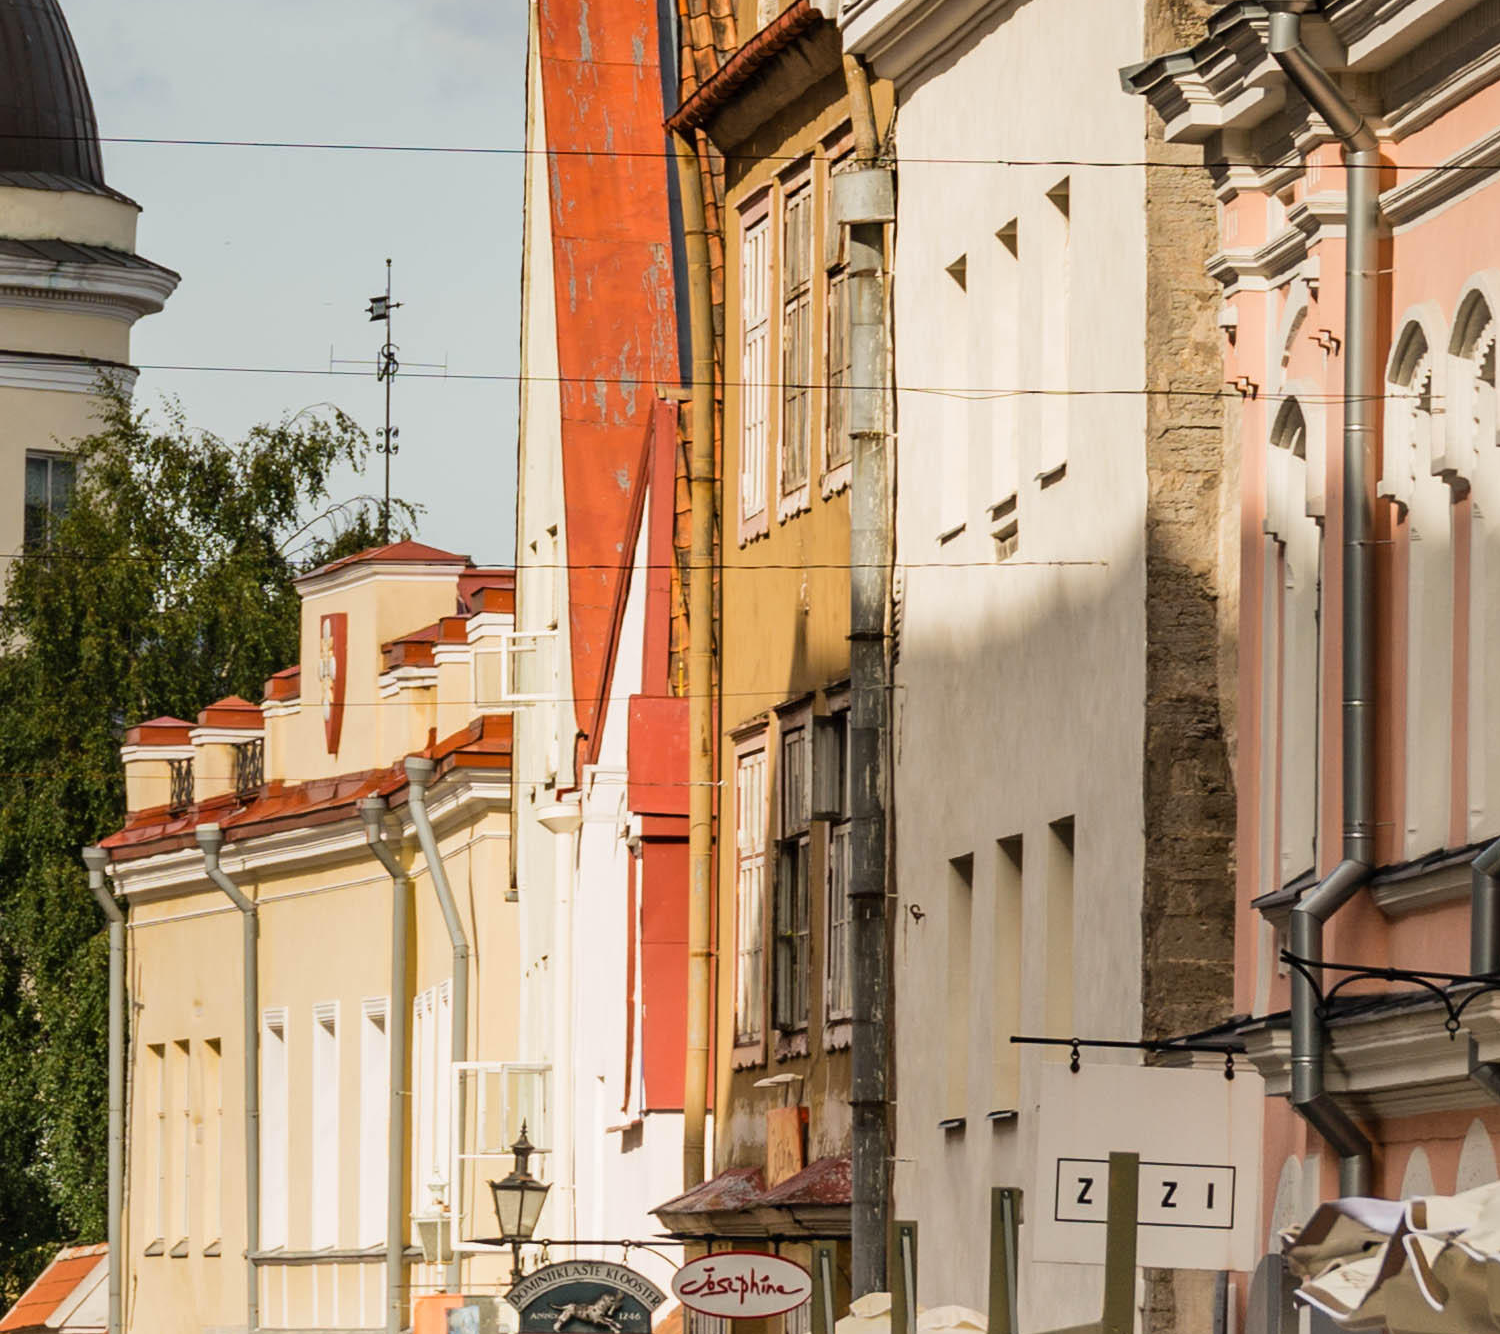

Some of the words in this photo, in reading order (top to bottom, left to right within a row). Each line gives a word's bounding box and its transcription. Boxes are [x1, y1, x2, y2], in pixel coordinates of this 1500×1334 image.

[1077, 1178, 1214, 1209] ZZI
[606, 1269, 661, 1307] KLOOSTER
[680, 1267, 804, 1305] Josephine
